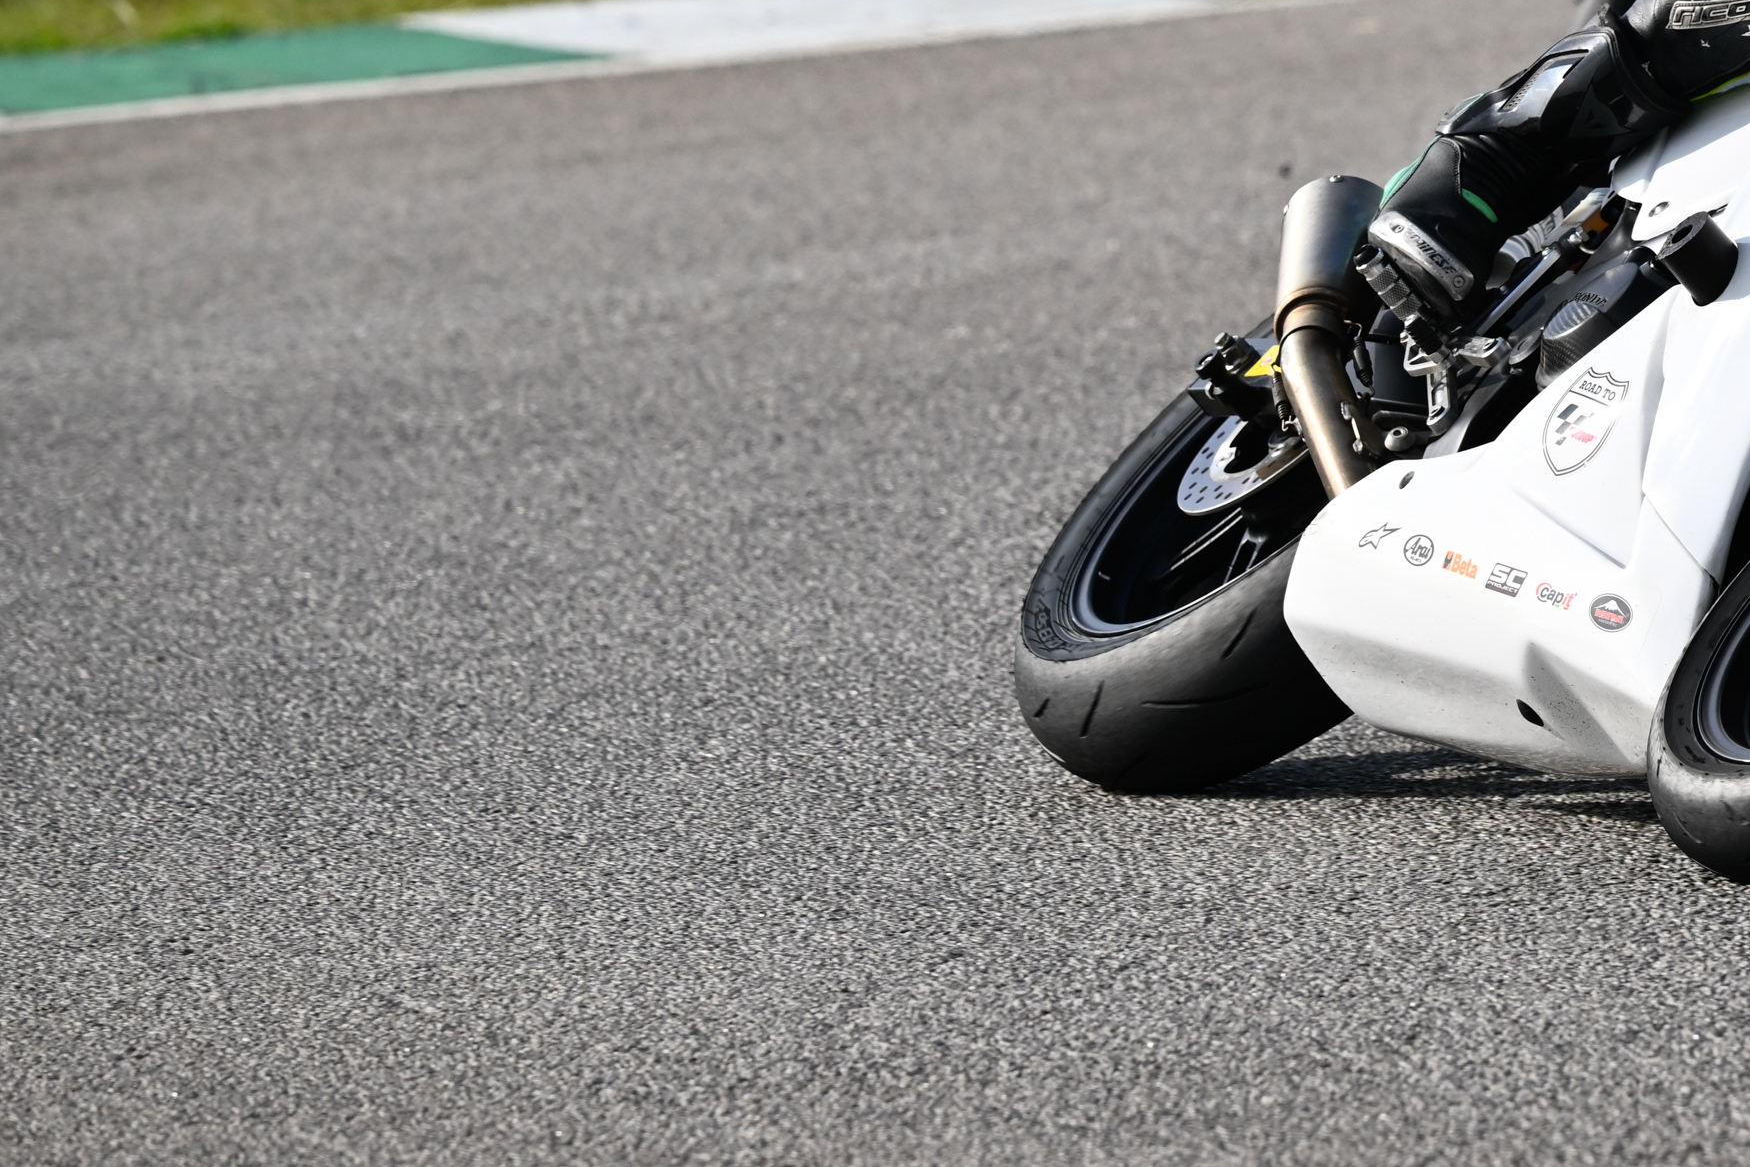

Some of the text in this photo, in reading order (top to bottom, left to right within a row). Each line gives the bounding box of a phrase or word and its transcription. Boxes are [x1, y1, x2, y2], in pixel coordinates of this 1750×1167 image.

[1579, 380, 1616, 401] ROAD TO
[1403, 537, 1432, 559] Arai
[1450, 553, 1478, 580] Beta
[1489, 564, 1528, 589] SC
[1487, 580, 1519, 595] PROJECT
